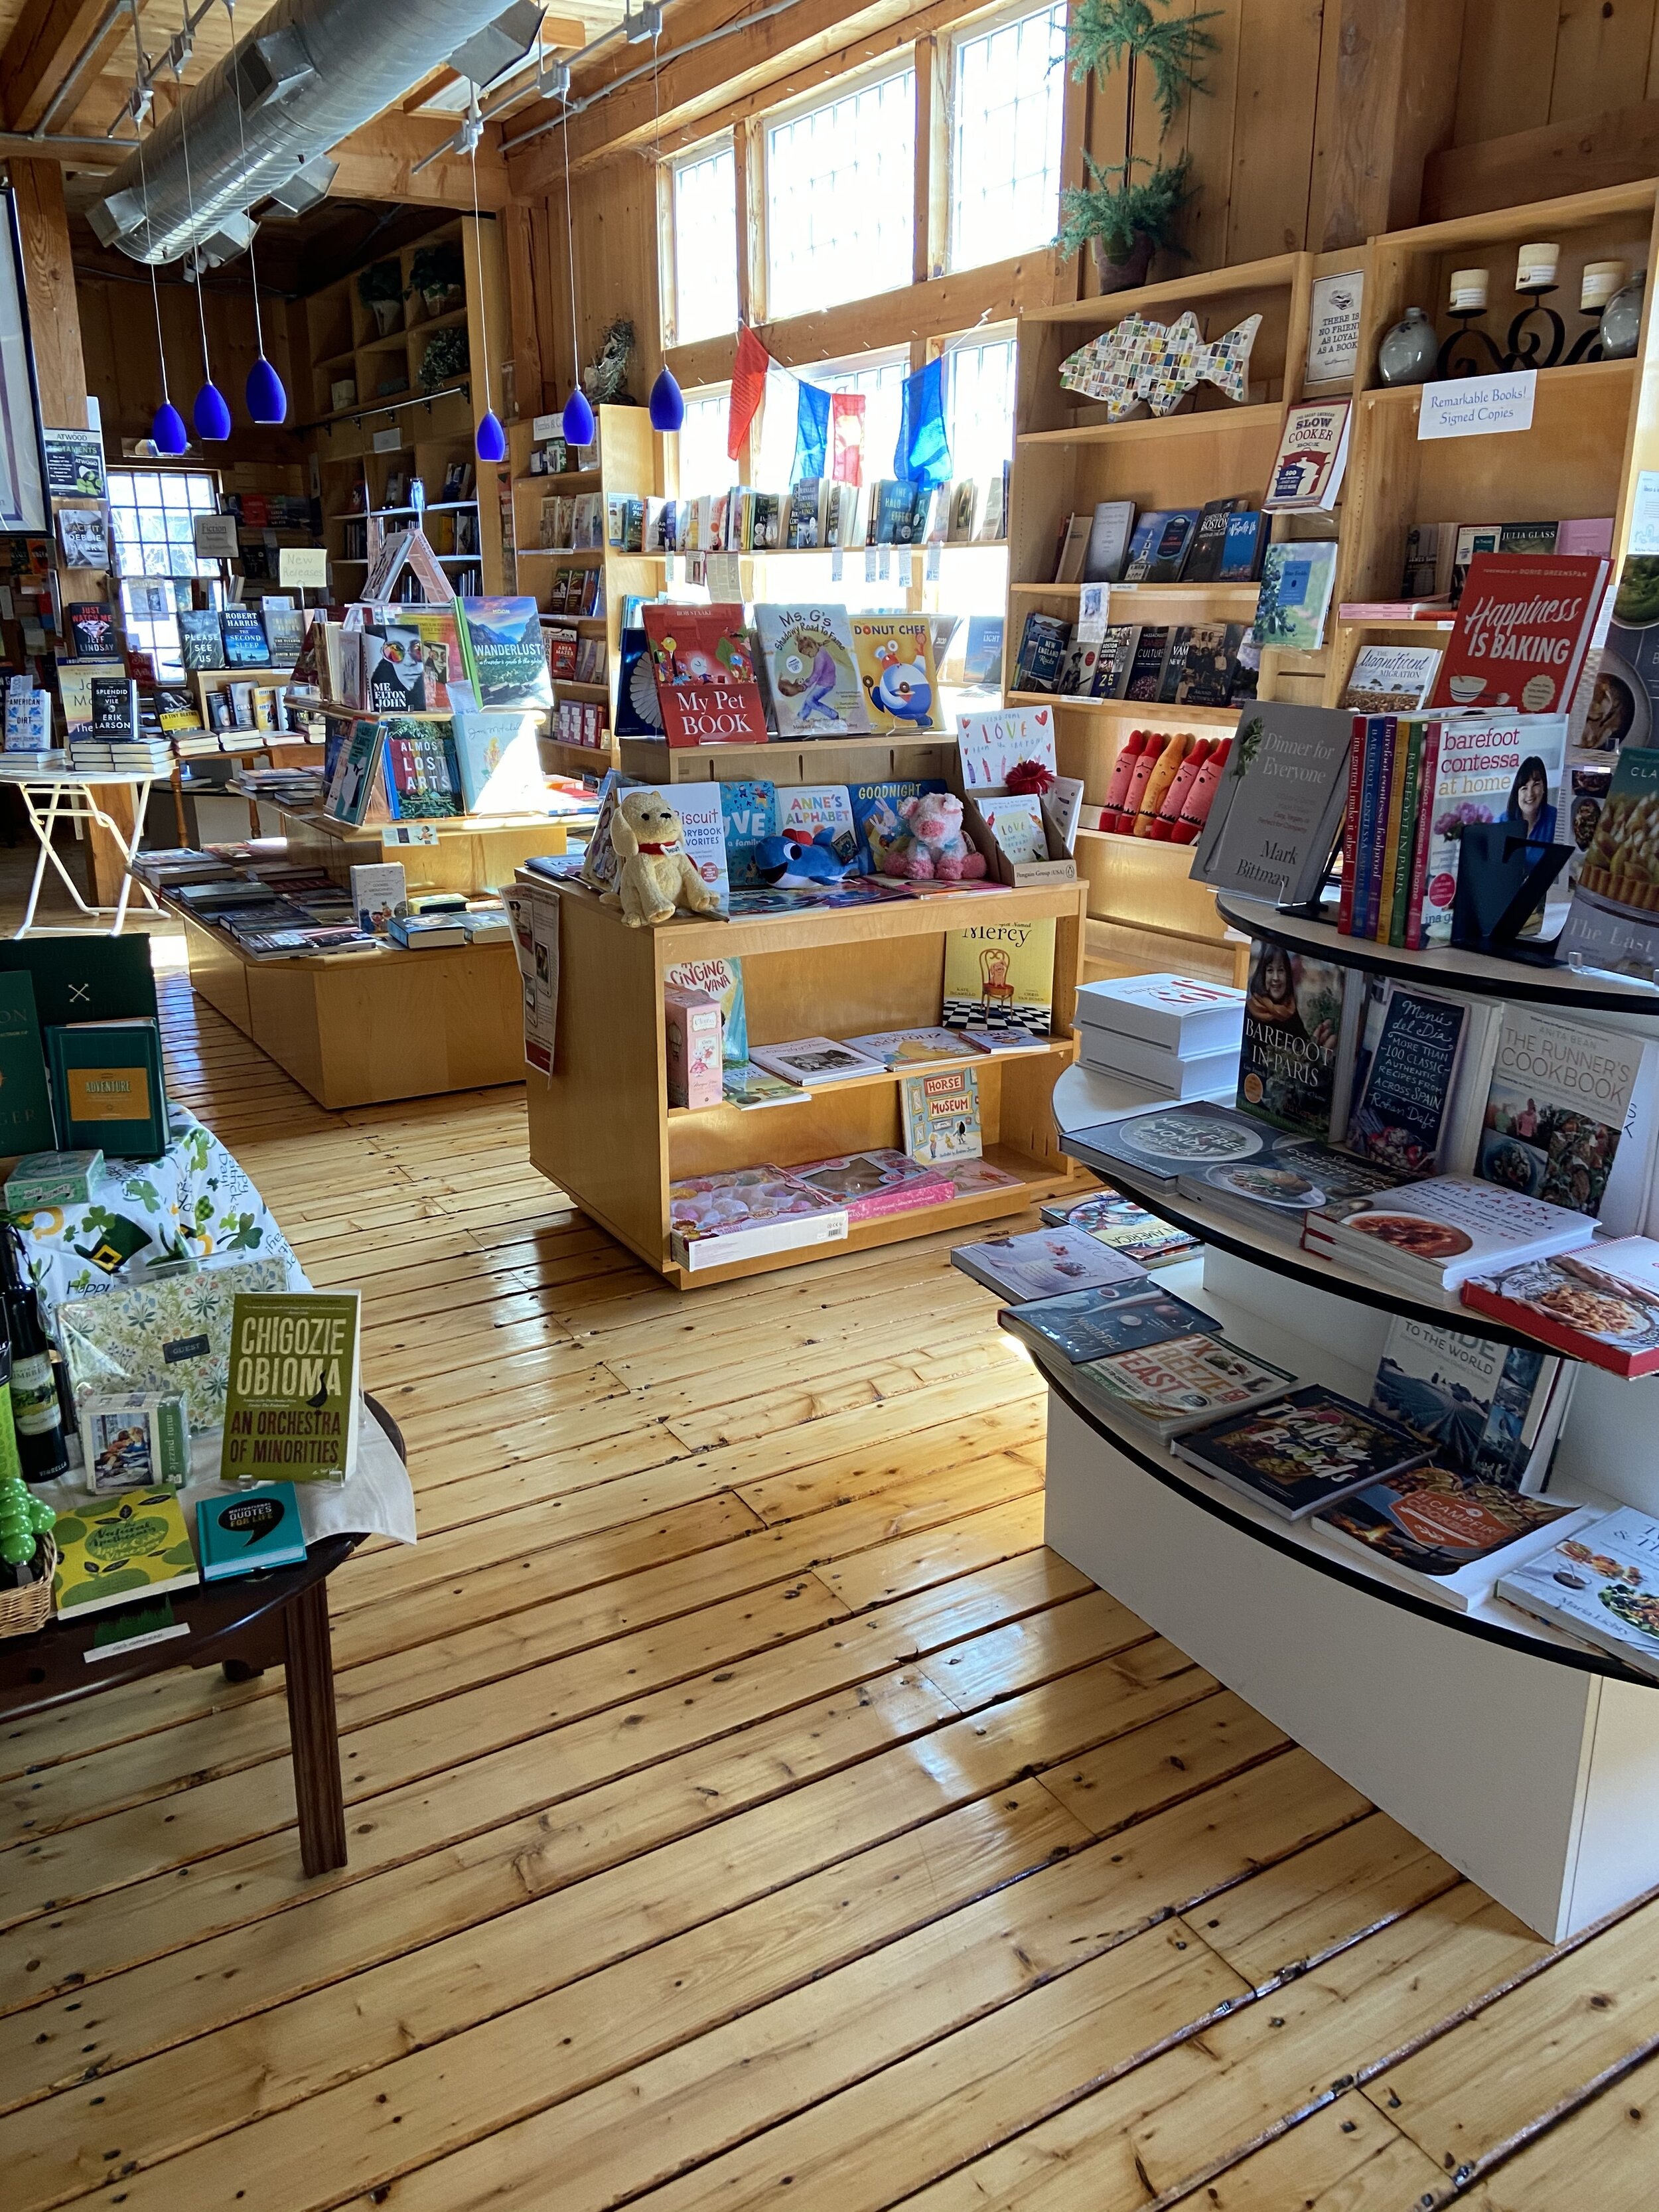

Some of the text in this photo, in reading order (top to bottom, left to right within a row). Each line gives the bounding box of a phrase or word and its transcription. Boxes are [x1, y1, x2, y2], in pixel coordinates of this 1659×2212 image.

[1323, 313, 1360, 326] THERE IS
[1319, 327, 1330, 336] NO
[1333, 332, 1357, 342] LOYAL
[1336, 341, 1358, 352] BOOK
[1431, 386, 1526, 409] Remarkable Books!
[1296, 417, 1333, 431] SLOW
[1439, 407, 1514, 426] Signed Copies
[1289, 429, 1333, 443] COOKER
[896, 487, 906, 496] THE
[885, 498, 901, 508] HALO
[202, 523, 226, 532] Fiction
[891, 512, 912, 522] EFFECT
[1202, 518, 1228, 530] BOSTON
[1502, 530, 1555, 540] JULIA GLASS
[287, 554, 313, 564] New
[283, 567, 324, 577] Releases
[778, 609, 832, 628] Ms. G's
[1464, 595, 1583, 637] Happiness
[774, 621, 846, 651] Shadowy Road To Fame
[854, 625, 926, 635] DONUT CHEF
[474, 644, 541, 656] WANDERLUST
[1038, 647, 1058, 658] ENGLAND
[1137, 648, 1163, 658] CULTURE
[1467, 632, 1571, 664] IS BAKING
[1356, 649, 1429, 670] Magnificent
[1379, 670, 1421, 678] MIGRATION
[374, 683, 391, 692] ME
[374, 691, 405, 700] ELTON
[375, 698, 406, 707] JOHN
[677, 691, 745, 716] My Pet
[681, 713, 753, 735] BOOK
[981, 721, 1027, 744] LOVE
[1263, 733, 1335, 761] Dinner for
[1443, 728, 1520, 751] barefoot
[403, 757, 446, 771] LOST
[1263, 757, 1327, 784] Everyone
[1441, 753, 1520, 773] contessa
[407, 776, 451, 790] ARTS
[859, 783, 921, 800] GOODNIGHT
[1439, 775, 1511, 796] at home
[790, 795, 843, 811] ANNE'S
[785, 809, 849, 825] ALPHABET
[1396, 753, 1416, 894] BAREFOOT IN PARIS
[1001, 822, 1025, 835] LOVE
[1260, 840, 1298, 865] Mark
[1035, 869, 1050, 878] Group
[1051, 868, 1064, 877] (USA)
[1235, 859, 1289, 888] Bittman
[962, 926, 1032, 948] Mercy
[1569, 917, 1652, 953] The Last
[704, 975, 731, 992] NANA
[1393, 1019, 1415, 1033] del
[1246, 1018, 1333, 1066] BAREFOOT
[1392, 1037, 1448, 1061] MORE THAN
[1505, 1027, 1630, 1082] THE RUNNER'S
[1252, 1045, 1319, 1086] IN PARIS
[1386, 1059, 1436, 1081] AUTHENTIC
[86, 1081, 130, 1093] ADVENTURE
[928, 1077, 960, 1092] HORSE
[1379, 1065, 1442, 1094] RECIPES FROM
[1502, 1047, 1625, 1106] COOKBOOK
[1374, 1078, 1443, 1110] ACROSS SPAIN
[932, 1098, 968, 1114] MUSEUM
[1407, 1106, 1435, 1129] Daft
[1133, 1131, 1191, 1156] COOKBOOK
[1140, 1125, 1221, 1153] MONDAY
[1157, 1117, 1247, 1153] MEAT FREE
[1287, 1148, 1362, 1177] COMFORT
[1445, 1180, 1552, 1221] PARADOX
[1490, 1189, 1566, 1217] PLANT
[1475, 1200, 1554, 1230] COOKBOOK
[1108, 1228, 1166, 1245] AMERICA
[241, 1316, 346, 1355] CHIGOZIE
[173, 1343, 200, 1355] GUEST
[1406, 1321, 1493, 1376] TO THE WORLD
[236, 1356, 341, 1396] OBIOMA
[1111, 1351, 1190, 1393] FEAST
[230, 1410, 341, 1436] AN ORCHESTRA
[166, 1439, 176, 1471] puzzle
[230, 1438, 339, 1463] OF MINORITIES
[230, 1506, 272, 1520] QUOTES
[230, 1514, 273, 1527] FOR LIFE
[1406, 1499, 1492, 1541] COOKBOOK
[1430, 1501, 1504, 1536] CAMPFIRE
[1560, 1596, 1593, 1617] Maria
